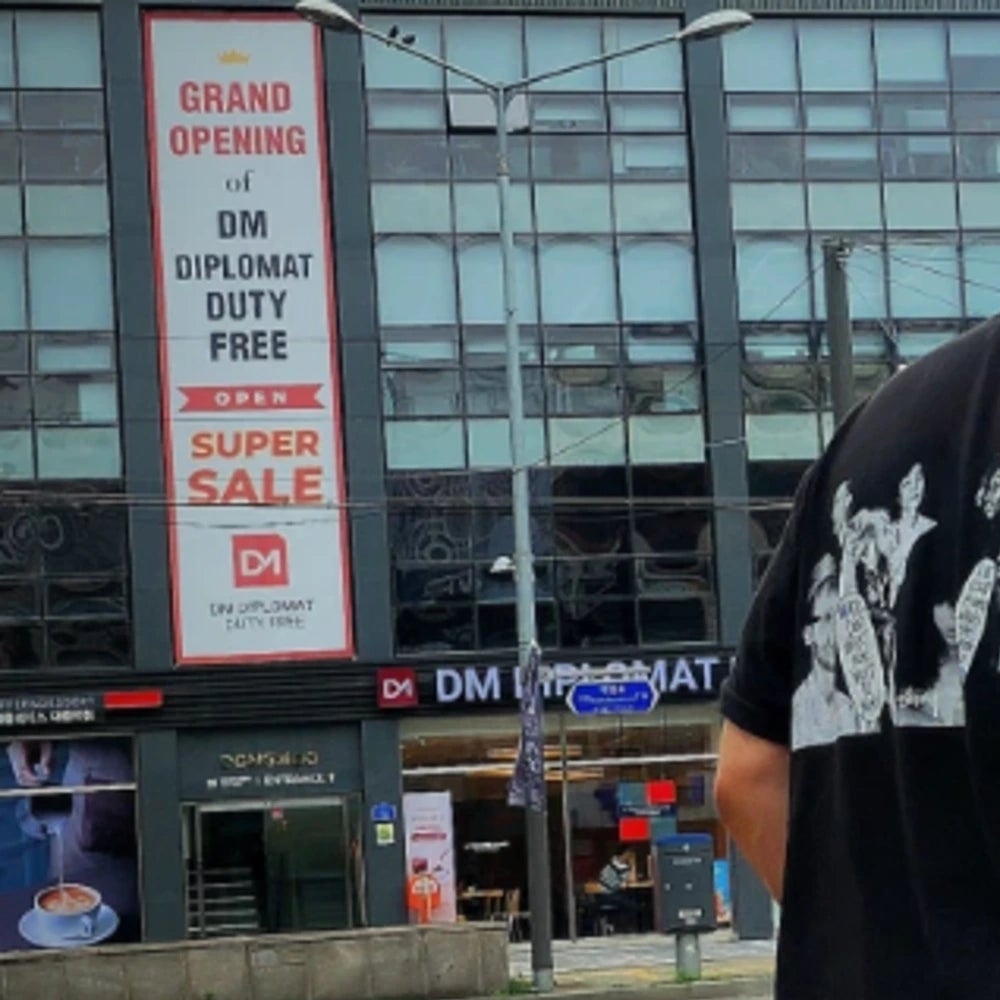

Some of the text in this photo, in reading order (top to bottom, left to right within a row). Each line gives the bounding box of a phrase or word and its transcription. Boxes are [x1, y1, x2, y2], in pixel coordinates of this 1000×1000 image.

[179, 81, 291, 114] GRAND
[169, 125, 306, 156] OPENING
[226, 170, 254, 193] of
[217, 210, 268, 240] DM
[174, 253, 313, 281] DIPLOMAT
[206, 289, 287, 321] DUTY
[210, 331, 288, 362] FREE
[214, 390, 288, 407] OPEN
[190, 430, 319, 459] SUPER
[186, 466, 323, 506] SALE
[436, 667, 500, 703] DM
